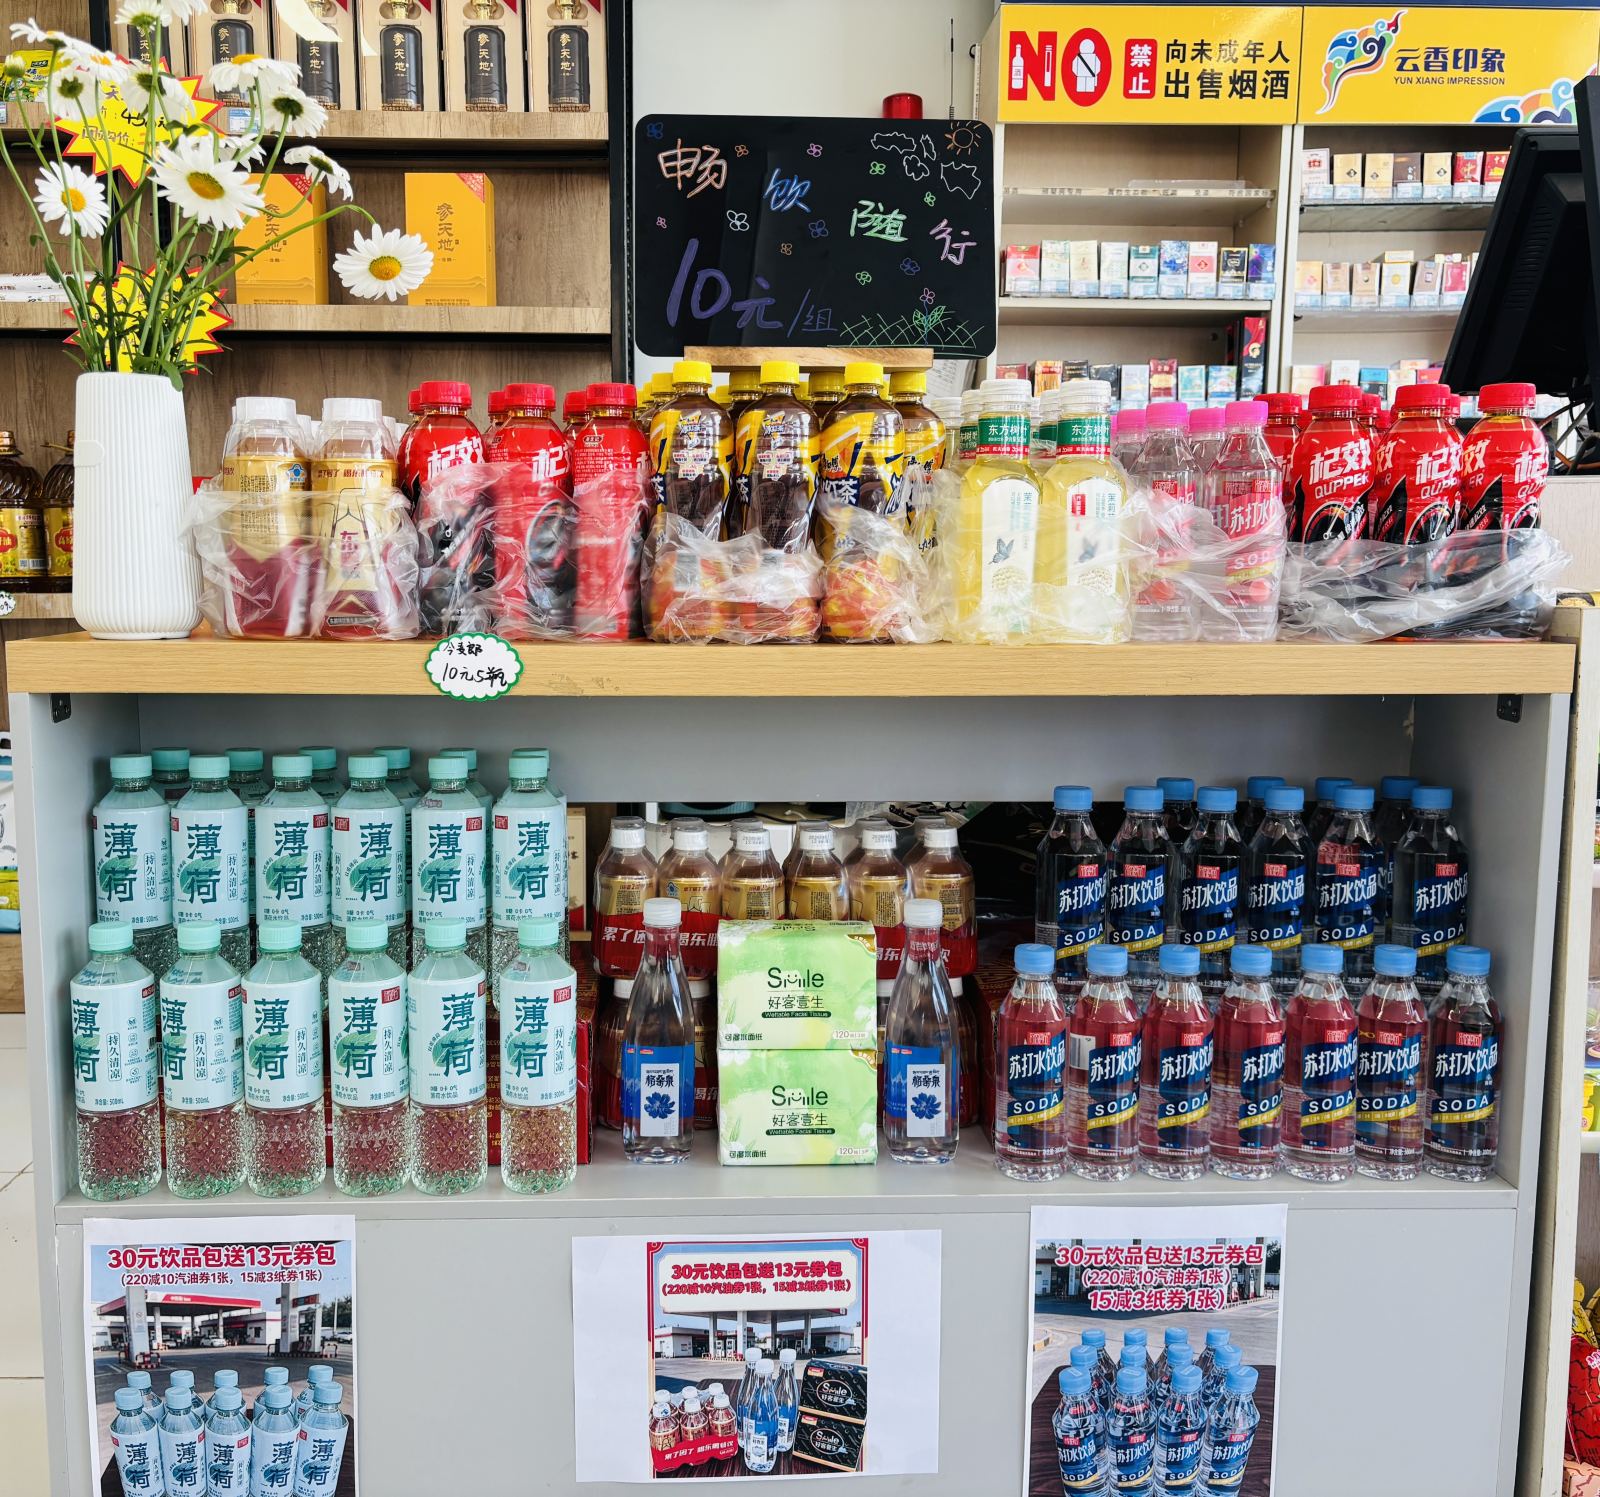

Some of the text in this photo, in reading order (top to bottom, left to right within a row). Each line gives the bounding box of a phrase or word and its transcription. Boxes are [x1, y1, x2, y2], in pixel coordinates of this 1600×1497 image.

[393, 32, 406, 71] 参天地
[478, 33, 490, 71] 参天地
[560, 33, 571, 71] 参天地
[1008, 28, 1112, 106] NO
[1129, 43, 1152, 94] 禁止
[1166, 39, 1290, 64] 向未成年人
[1395, 46, 1505, 72] 云香印象
[1164, 68, 1290, 100] 出售烟酒
[1447, 77, 1505, 85] IMPRESSION
[436, 202, 455, 252] 参天地
[988, 424, 1027, 436] 东方树叶
[532, 443, 568, 482] 杞
[1315, 471, 1369, 499] QUPPER
[443, 642, 483, 656] 今麦郎
[443, 663, 507, 687] 10元5瓶
[104, 823, 138, 903] 薄荷
[145, 855, 156, 897] 持久清凉
[187, 823, 222, 904] 薄荷
[228, 856, 238, 899] 持久清凉
[274, 821, 309, 901] 薄荷
[314, 853, 323, 896] 持久清凉
[360, 823, 392, 902] 薄荷
[429, 824, 462, 903] 薄荷
[518, 822, 550, 900] 薄荷
[1110, 875, 1164, 910] 苏打水饮品
[1182, 876, 1237, 911] 苏打水饮品
[1249, 874, 1304, 908] 苏打水饮品
[1320, 874, 1376, 908] 苏打水饮品
[1064, 922, 1104, 946] SODA
[1113, 925, 1155, 943] SODA
[1184, 927, 1228, 944] SODA
[1251, 925, 1295, 942] SODA
[1321, 925, 1368, 942] SODA
[1421, 922, 1464, 945] SODA
[767, 967, 824, 988] Smile
[768, 994, 824, 1009] 好客壹生
[73, 998, 100, 1082] 薄荷
[162, 998, 187, 1081] 薄荷
[254, 998, 290, 1080] 薄荷
[297, 1030, 306, 1074] 持久清凉
[343, 996, 378, 1079] 薄荷
[384, 1028, 393, 1073] 持久清凉
[441, 992, 476, 1079] 薄荷
[514, 996, 549, 1079] 薄荷
[555, 1028, 564, 1073] 持久清凉
[108, 1034, 120, 1079] 持久清凉
[195, 1034, 206, 1079] 持久清凉
[1009, 1041, 1065, 1080] 苏打水饮品
[1359, 1042, 1420, 1075] 苏打水饮品
[1435, 1042, 1498, 1078] 苏打水饮品
[645, 1074, 674, 1088] 格桑泉
[772, 1085, 828, 1106] Smile
[772, 1112, 828, 1126] 好客壹生
[1013, 1092, 1059, 1114] SODA
[1095, 1092, 1137, 1116] SODA
[1166, 1092, 1208, 1116] SODA
[1248, 1089, 1283, 1115] SODA
[1309, 1091, 1353, 1113] SODA
[1361, 1095, 1410, 1110] SODA
[1438, 1095, 1489, 1112] SODA
[108, 1245, 336, 1269] 30元饮品包送13元券包
[671, 1261, 842, 1279] 30元饮品包送13元券包
[1056, 1246, 1263, 1265] 30元饮品包送13元券包
[1089, 1289, 1225, 1310] 15减3纸券1张)
[125, 1443, 150, 1488] 薄荷
[176, 1442, 197, 1487] 薄荷
[213, 1443, 234, 1488] 薄荷
[271, 1441, 294, 1488] 薄荷
[308, 1439, 336, 1485] 薄荷
[1064, 1470, 1092, 1481] SODA
[1121, 1465, 1151, 1481] SODA
[1170, 1464, 1197, 1480] SODA
[1213, 1465, 1244, 1479] SODA
